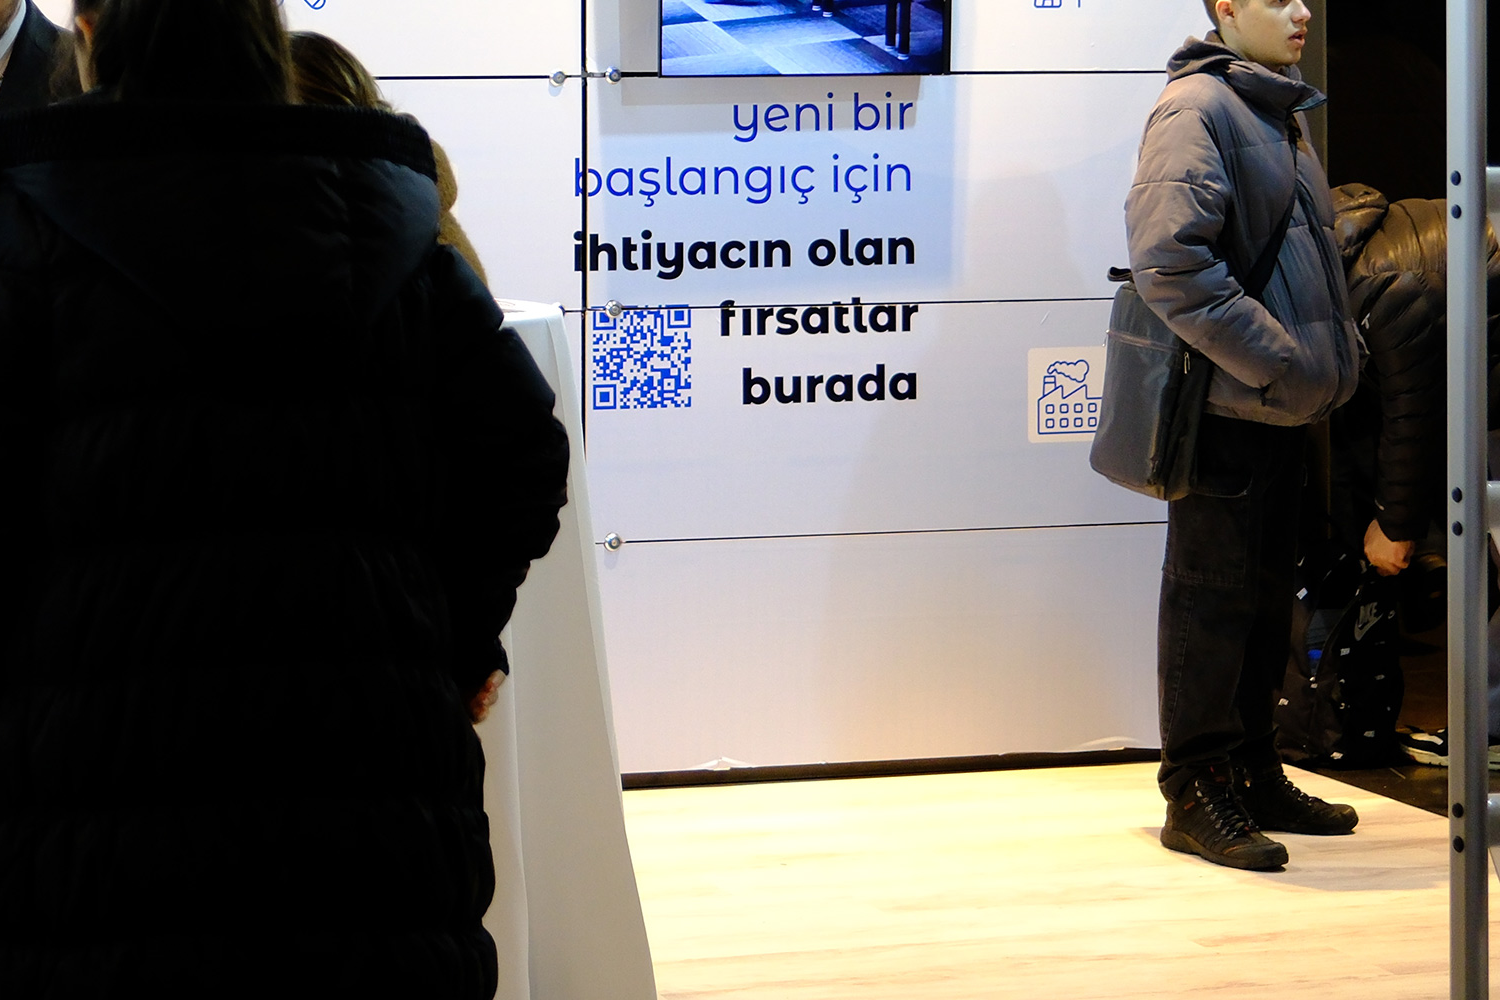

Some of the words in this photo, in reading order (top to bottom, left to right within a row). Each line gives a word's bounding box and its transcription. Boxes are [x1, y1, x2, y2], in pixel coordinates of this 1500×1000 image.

[732, 92, 834, 143] yeni
[852, 91, 914, 131] bir
[573, 156, 815, 208] başlangıç
[831, 152, 912, 204] için
[573, 229, 792, 280] ihtiyacın
[807, 228, 915, 267] olan
[719, 296, 919, 337] fırsatlar
[742, 363, 917, 405] burada
